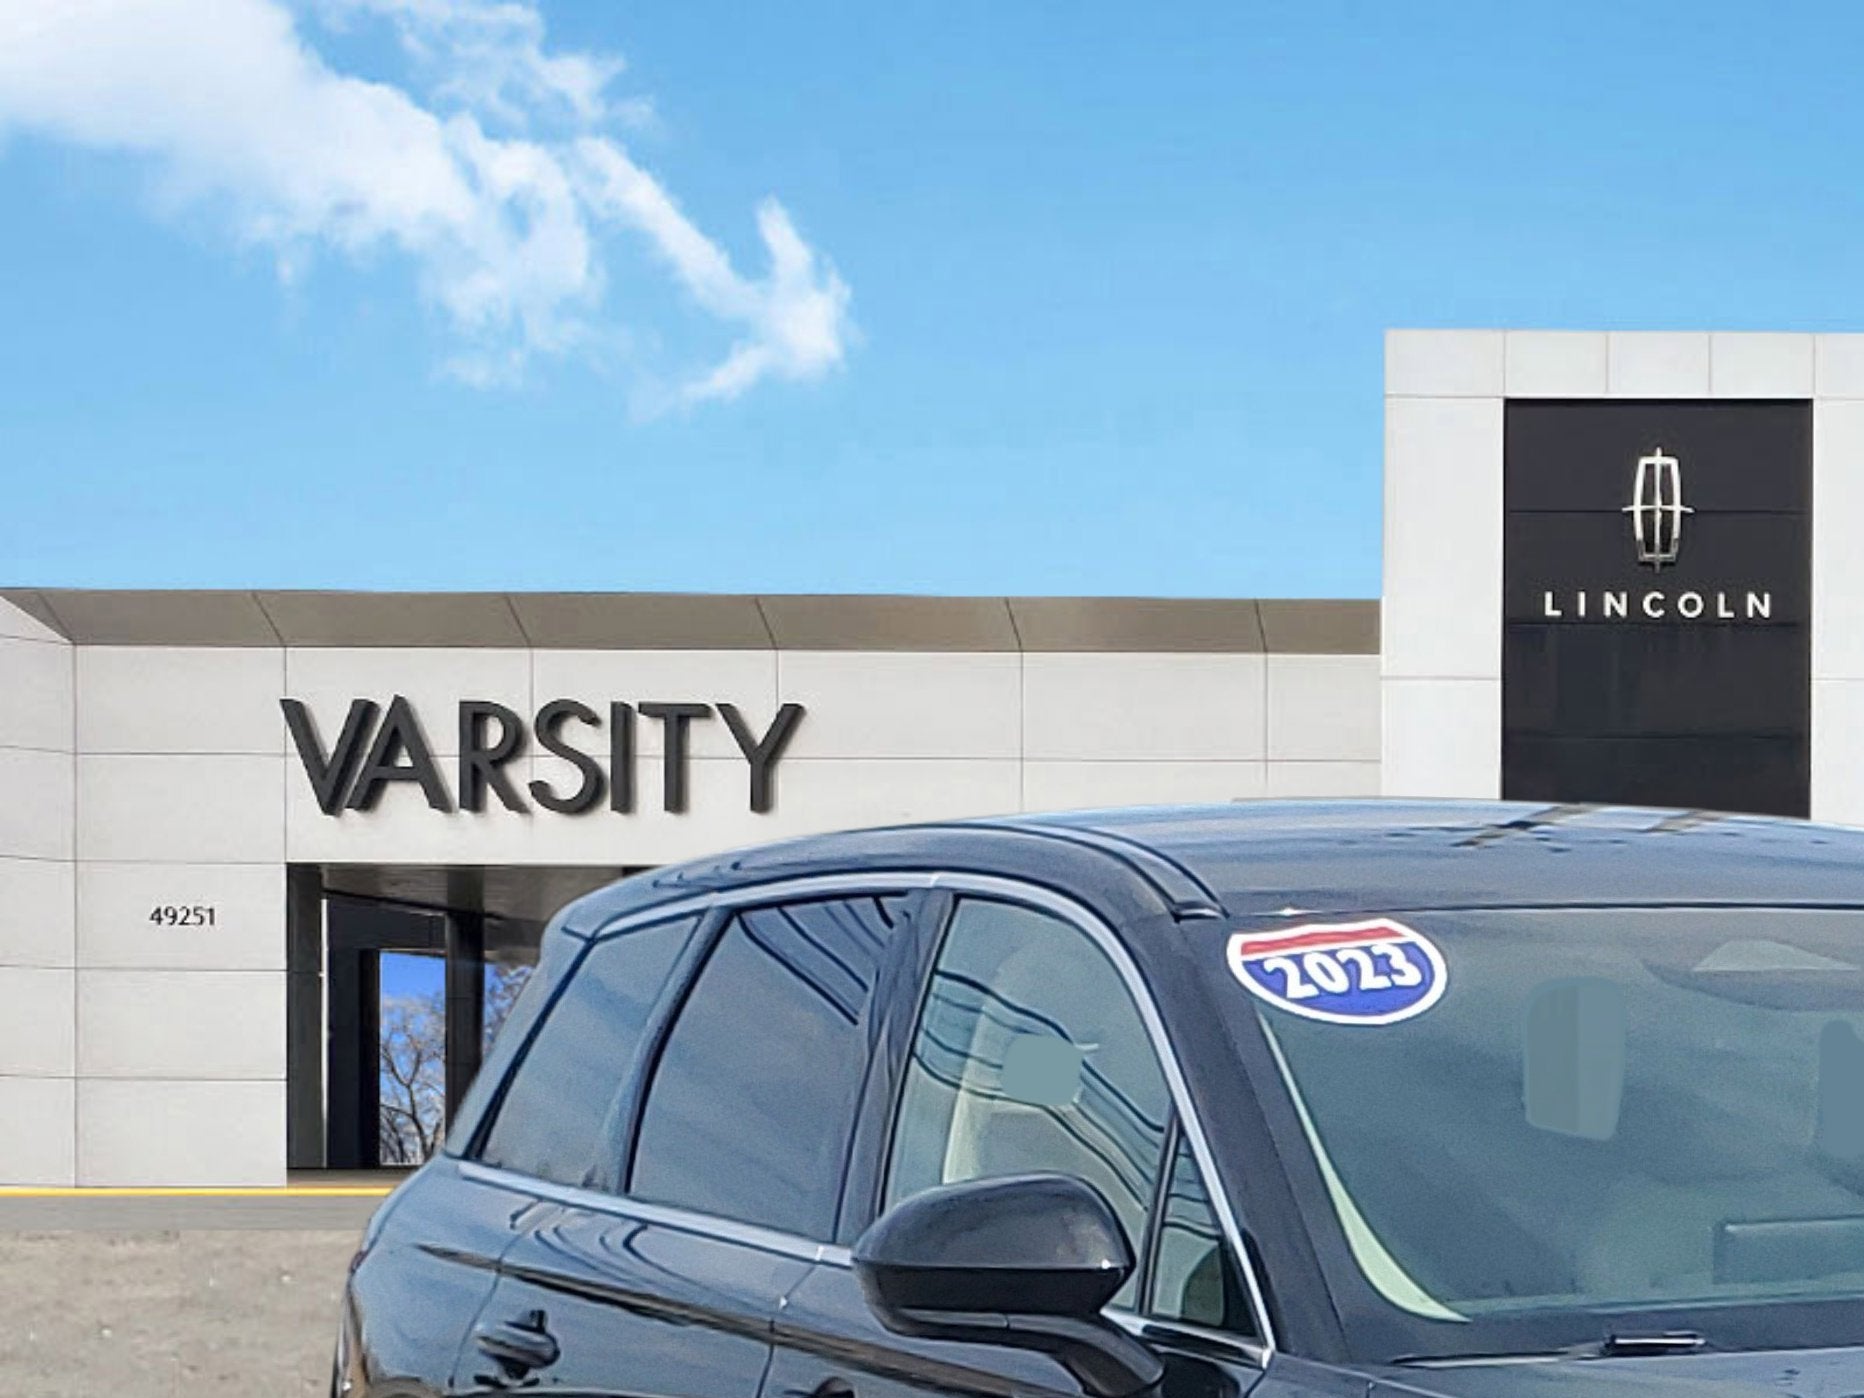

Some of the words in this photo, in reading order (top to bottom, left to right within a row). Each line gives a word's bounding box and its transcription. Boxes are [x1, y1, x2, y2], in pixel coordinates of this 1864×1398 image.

[1544, 591, 1771, 618] LINCOLN
[279, 694, 806, 816] VARSITY
[149, 905, 215, 926] 49251
[1263, 943, 1422, 999] 2023
